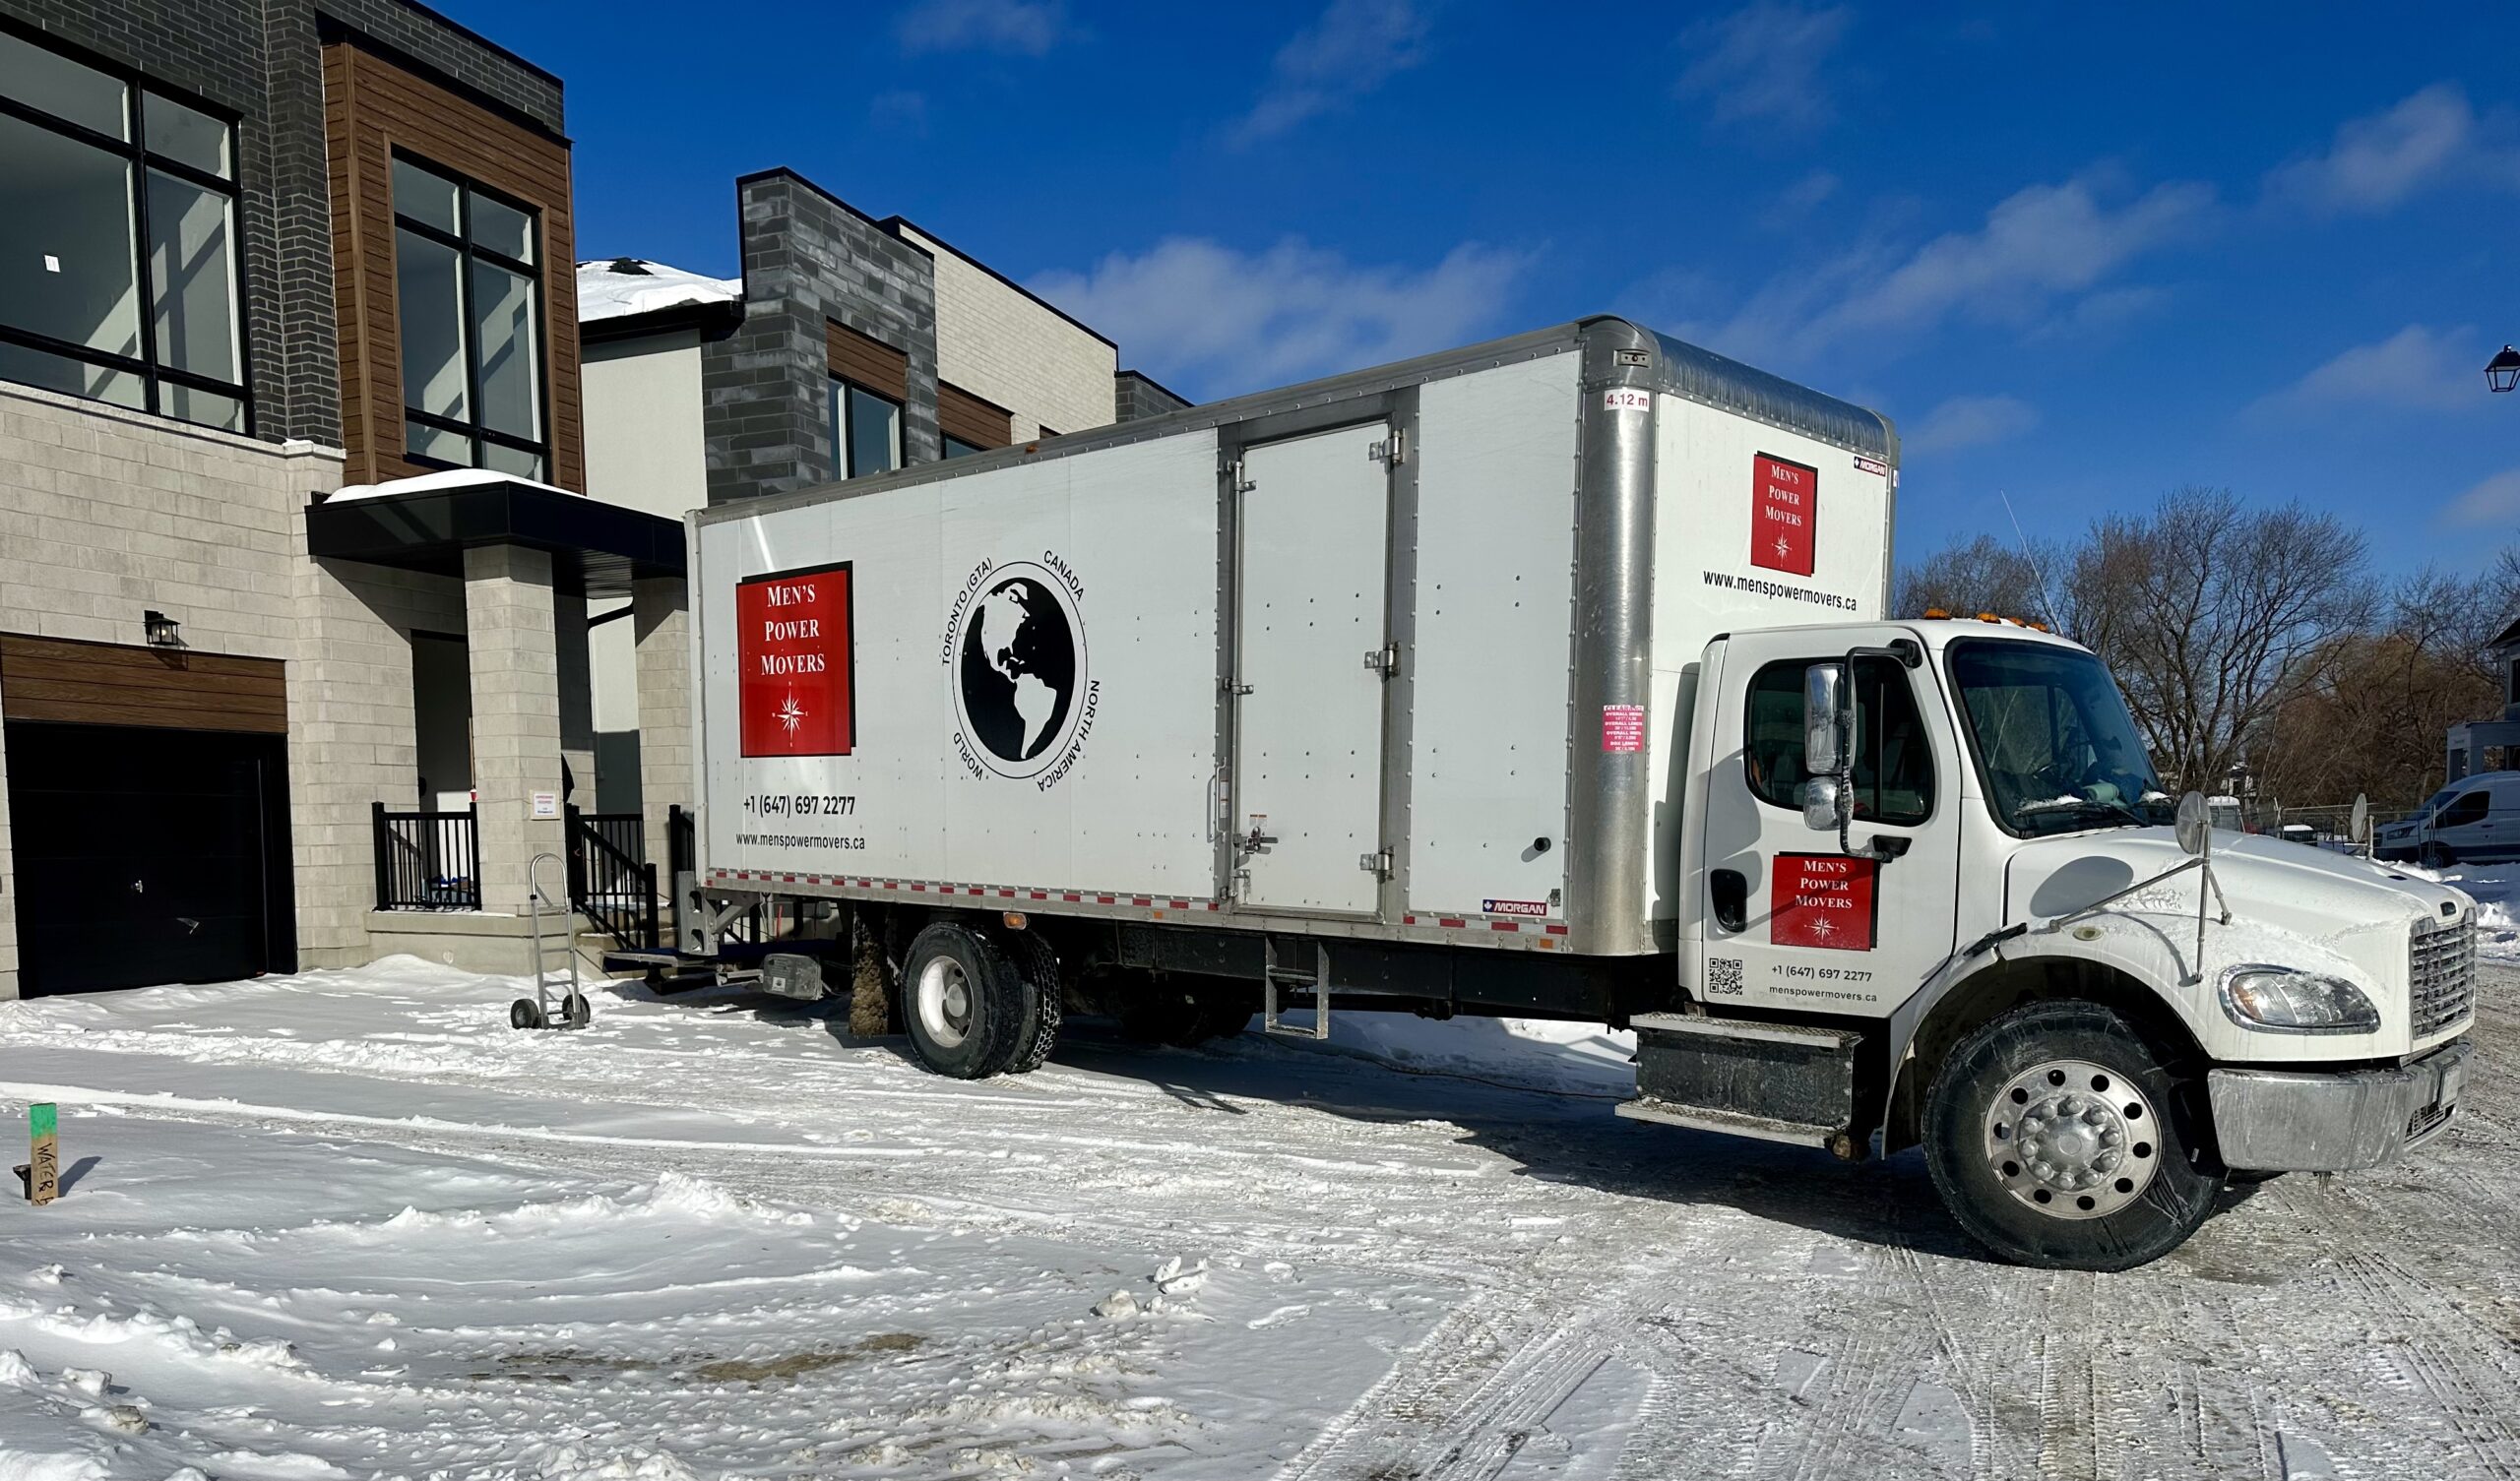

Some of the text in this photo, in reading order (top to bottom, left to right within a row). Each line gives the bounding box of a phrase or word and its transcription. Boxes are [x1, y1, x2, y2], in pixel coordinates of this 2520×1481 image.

[1606, 394, 1648, 406] 4.12 m
[1771, 464, 1799, 485] MEN'S
[1768, 484, 1799, 506] POWER
[1765, 505, 1801, 526] MOVERS
[1043, 550, 1084, 601] CANADA
[766, 584, 816, 607] MEN'S
[1703, 570, 1857, 611] www.menspowermovers.ca
[942, 557, 992, 666] TORONTO (GTA)
[765, 619, 819, 642] POWER
[761, 653, 825, 676] MOVERS
[1037, 680, 1101, 792] NORTH AMERICA
[953, 732, 983, 781] WORLD
[743, 795, 855, 819] +1 (647) 697 2277
[736, 833, 865, 850] www.menspowermovers.ca
[1803, 860, 1847, 873] MEN'S
[1800, 877, 1849, 891] POWER
[1494, 902, 1544, 914] MORGAN
[1796, 895, 1853, 908] MOVERS
[1772, 965, 1872, 982] +1 (647) 697 2277
[1769, 986, 1877, 1002] menspowermovers.ca
[37, 1142, 56, 1192] WATER
